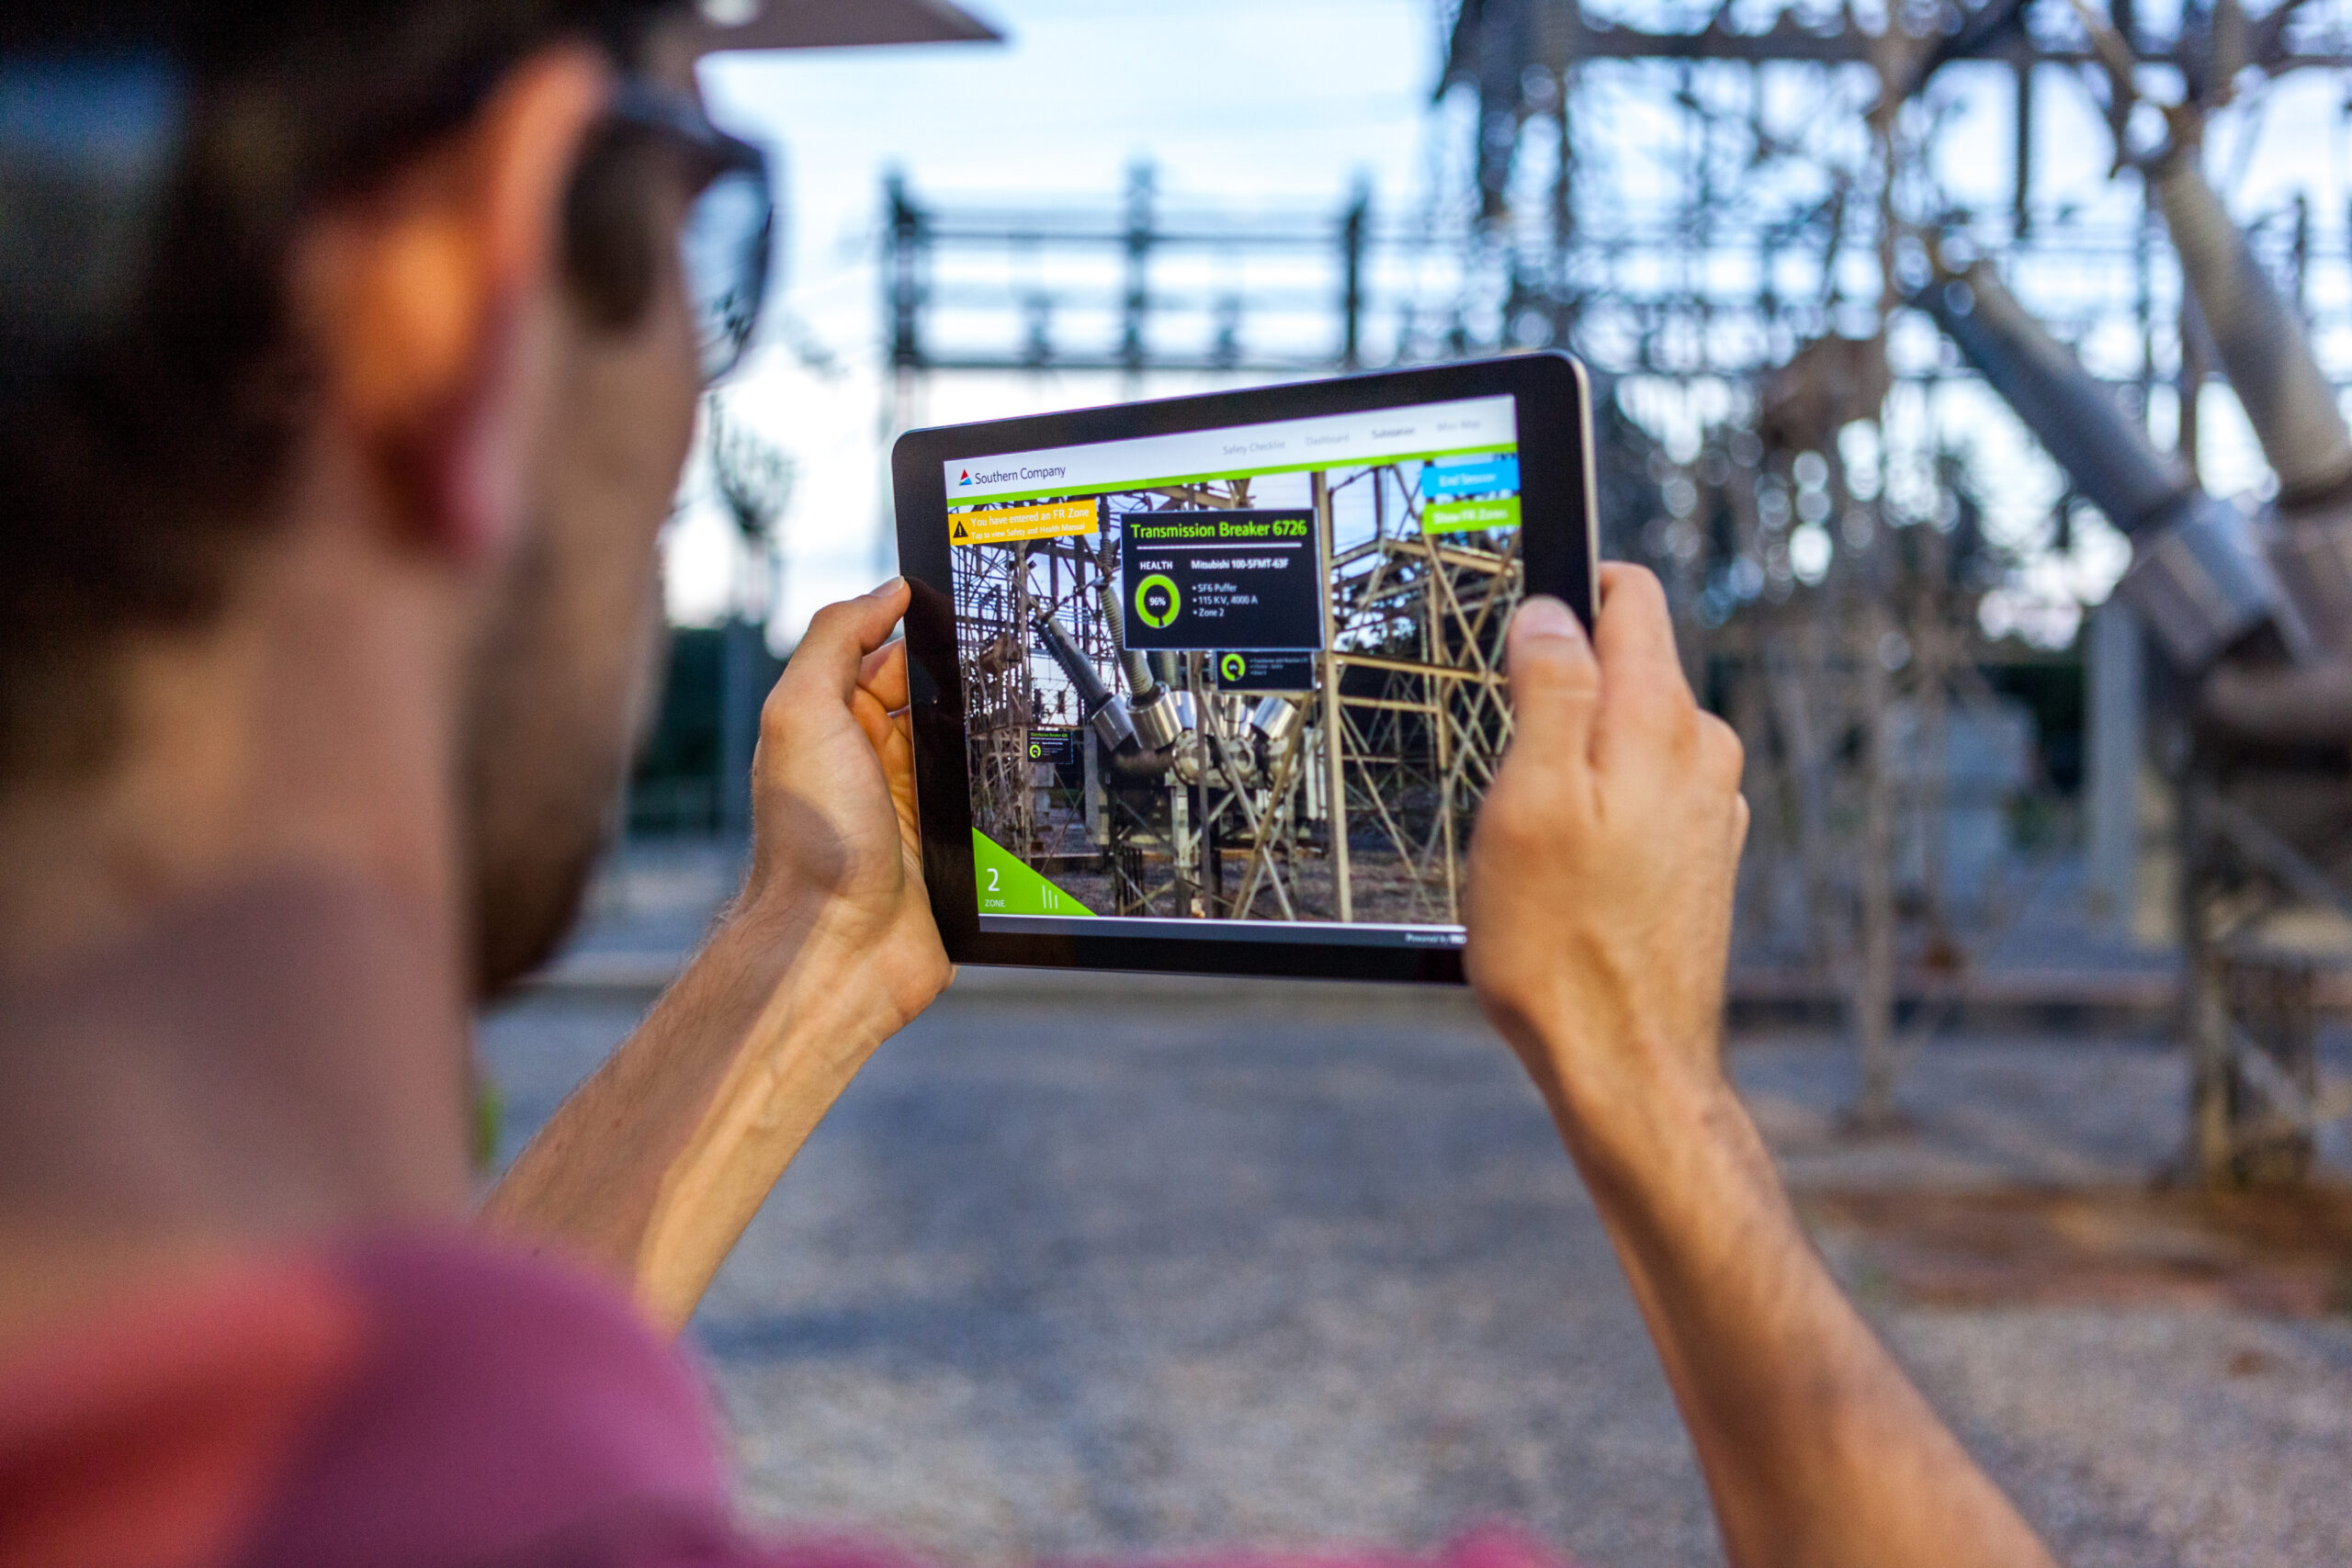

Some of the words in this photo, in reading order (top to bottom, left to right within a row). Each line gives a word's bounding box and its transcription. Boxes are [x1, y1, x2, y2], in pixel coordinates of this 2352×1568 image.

[1223, 445, 1247, 456] Safety
[1249, 440, 1286, 453] Checklist
[975, 470, 1018, 485] Southern
[1020, 466, 1066, 479] Company
[970, 517, 988, 527] You
[989, 515, 1008, 525] have
[1009, 512, 1039, 524] entered
[1040, 513, 1051, 521] an
[1053, 509, 1065, 519] FR
[1068, 507, 1090, 519] Zone
[971, 532, 983, 540] Tap
[984, 531, 990, 539] to
[991, 530, 1005, 538] view
[1006, 527, 1025, 538] Safety
[1027, 525, 1038, 535] and
[1040, 525, 1060, 534] Health
[1061, 522, 1086, 533] Manual
[1130, 523, 1216, 538] Transmission
[1218, 521, 1271, 537] Breaker
[1272, 519, 1307, 536] 6726
[1139, 561, 1173, 570] HEALTH
[1191, 558, 1230, 570] Mitsubishi
[1197, 583, 1214, 592] SF6
[1215, 582, 1238, 592] Puffer
[1149, 596, 1167, 606] 96%
[1198, 596, 1212, 604] 115
[1214, 596, 1229, 606] KV,
[1230, 595, 1250, 604] 4000
[1250, 596, 1258, 604] A
[1198, 608, 1218, 617] Zone
[1218, 607, 1225, 616] 2
[987, 868, 1001, 892] 2
[985, 899, 1005, 908] ZONE
